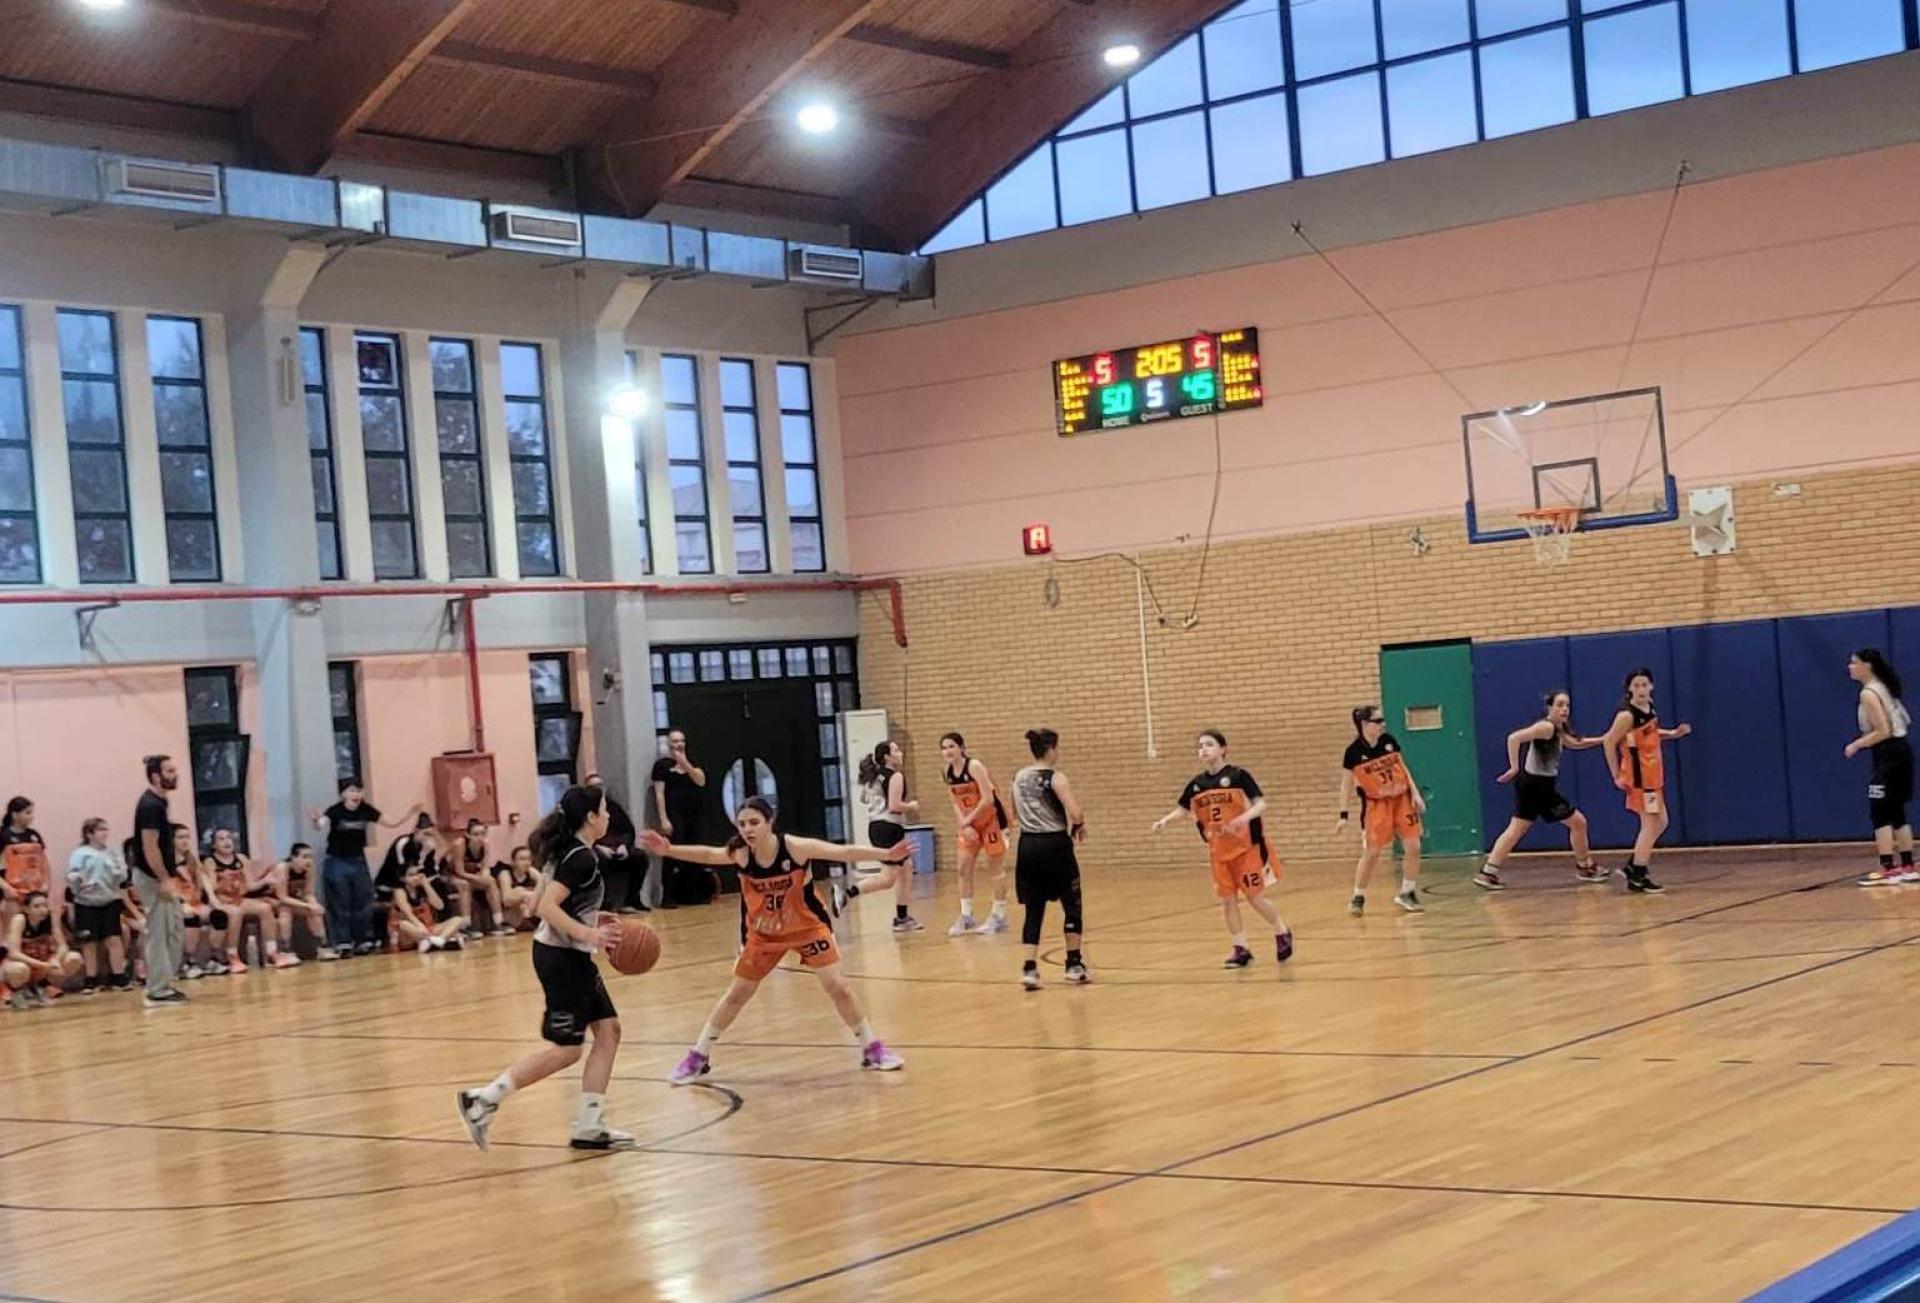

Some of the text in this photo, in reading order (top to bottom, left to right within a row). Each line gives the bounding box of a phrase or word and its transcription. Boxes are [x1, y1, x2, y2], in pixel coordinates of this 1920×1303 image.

[1094, 356, 1113, 385] 5
[1193, 340, 1211, 369] 5
[1101, 371, 1214, 415] 50 5 45
[1243, 872, 1260, 889] 12
